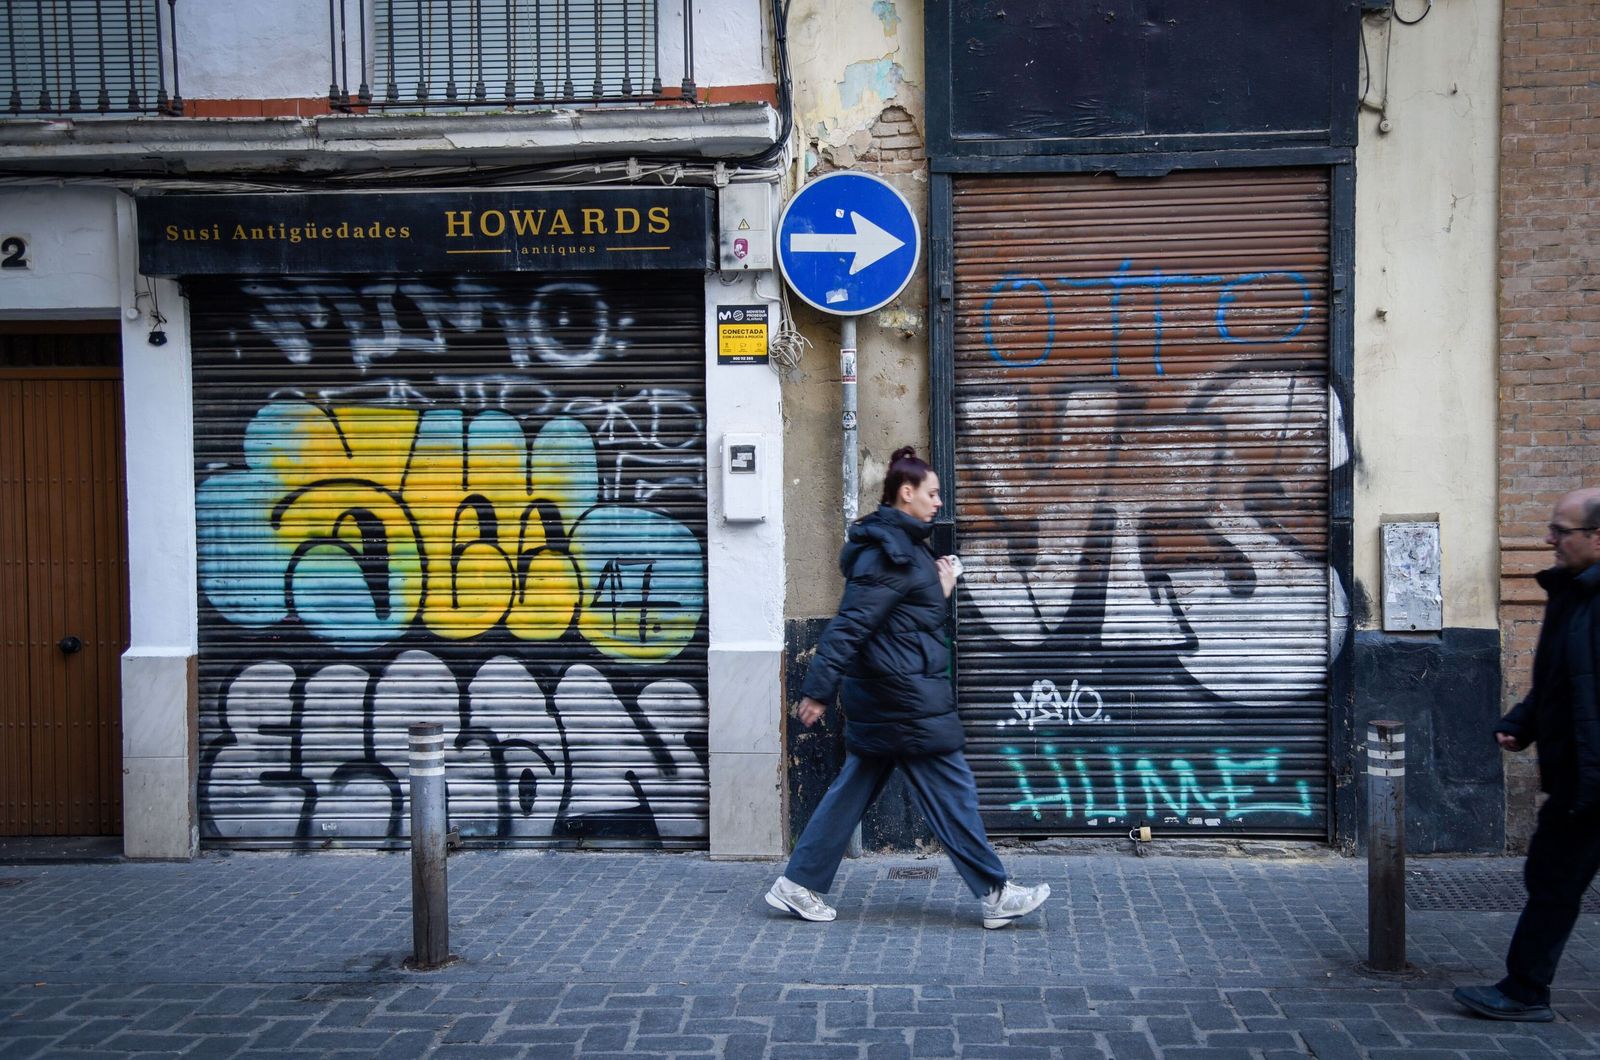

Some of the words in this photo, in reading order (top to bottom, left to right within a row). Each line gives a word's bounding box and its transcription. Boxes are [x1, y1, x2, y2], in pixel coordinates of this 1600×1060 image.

[166, 225, 220, 241] Susi
[232, 222, 411, 243] Antigüedades
[445, 207, 671, 237] HOWARDS
[1, 236, 27, 268] 2
[521, 244, 597, 256] antiques
